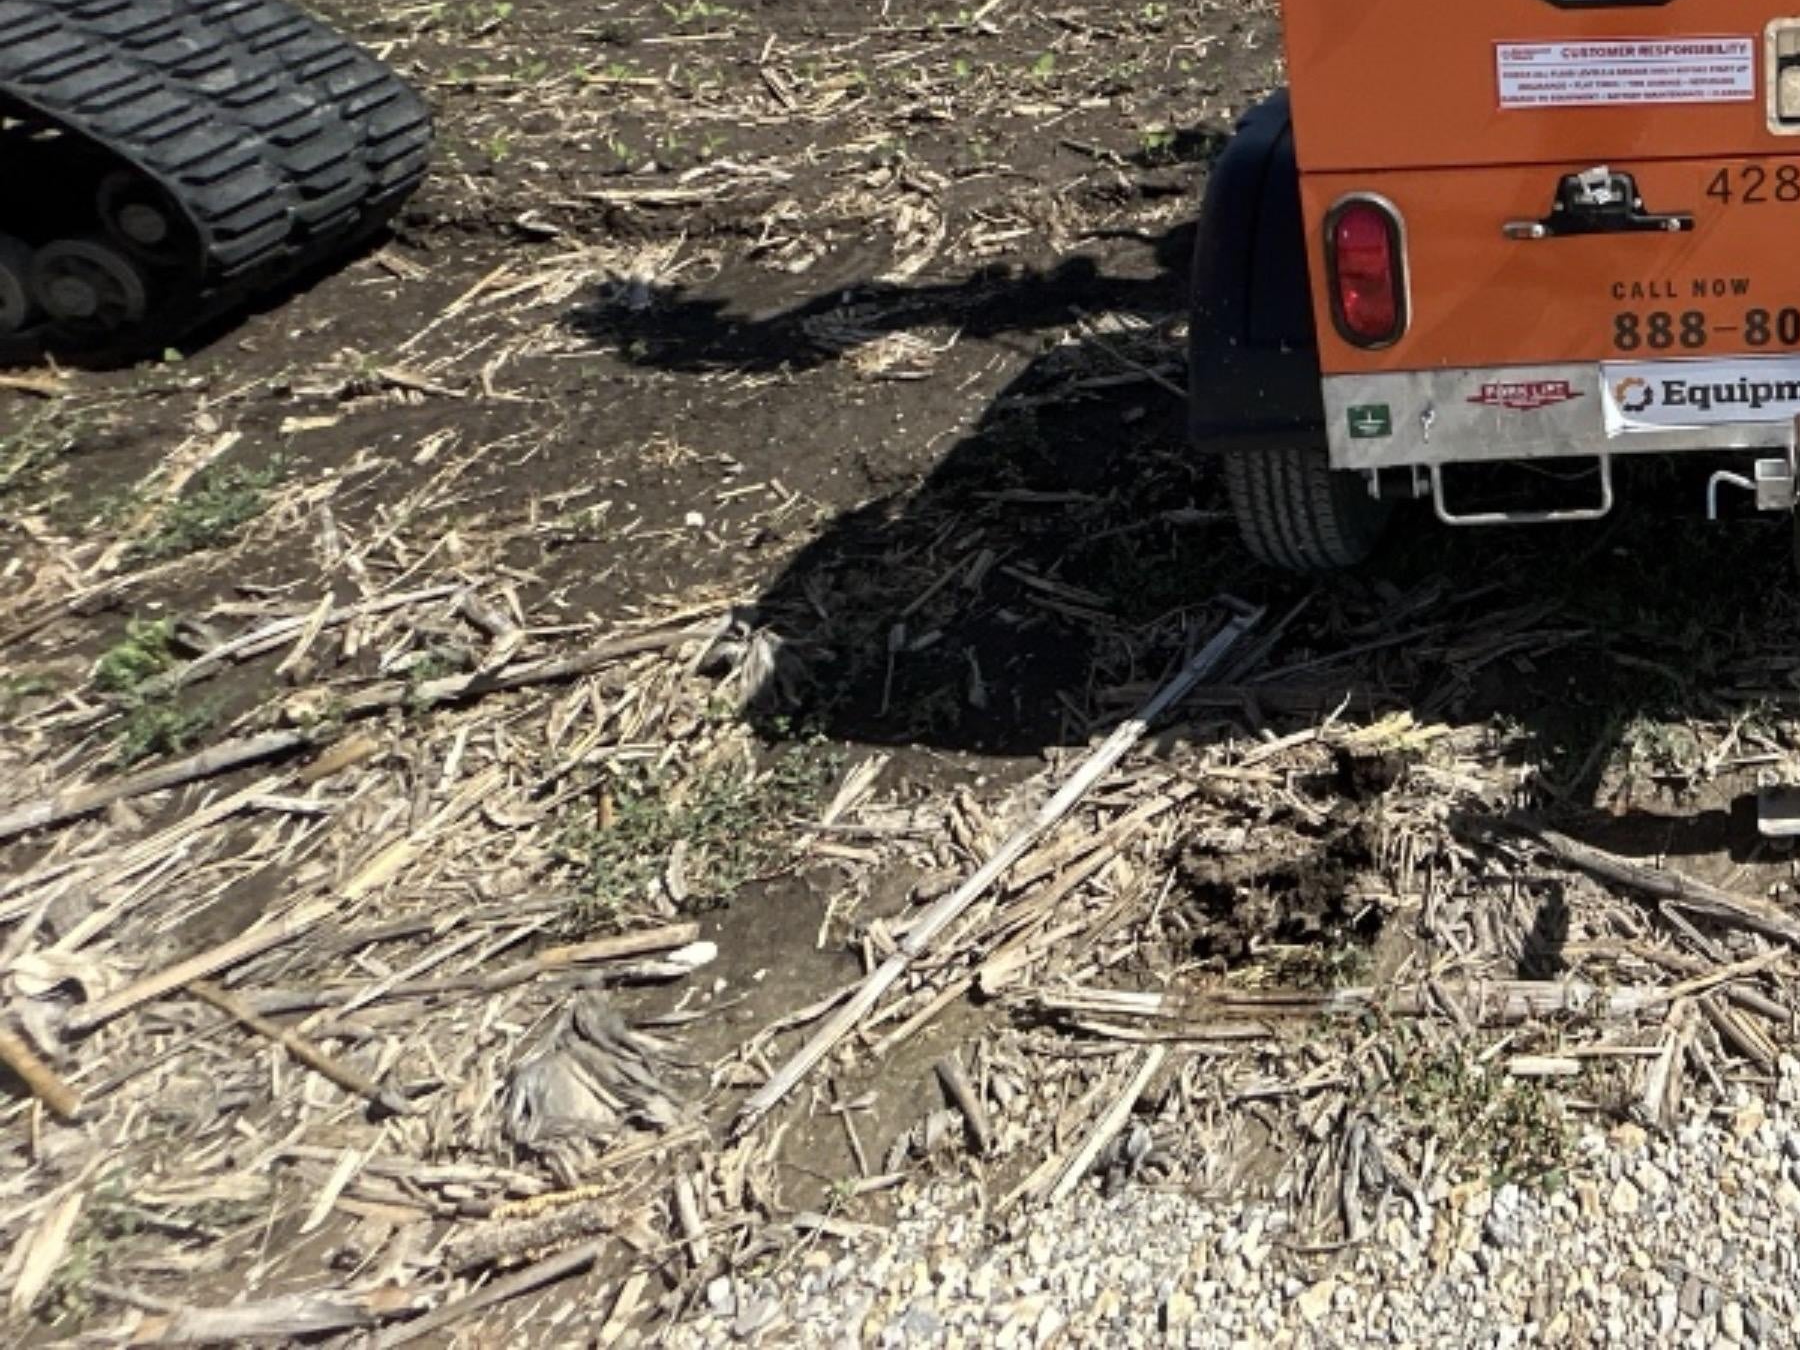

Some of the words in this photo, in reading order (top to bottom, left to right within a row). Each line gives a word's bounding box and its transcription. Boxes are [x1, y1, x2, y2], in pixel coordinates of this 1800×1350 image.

[1561, 45, 1636, 59] CUSTOMER
[1639, 43, 1748, 58] RESPONSIBILITY
[1612, 280, 1678, 300] CALL
[1692, 278, 1750, 296] NOW
